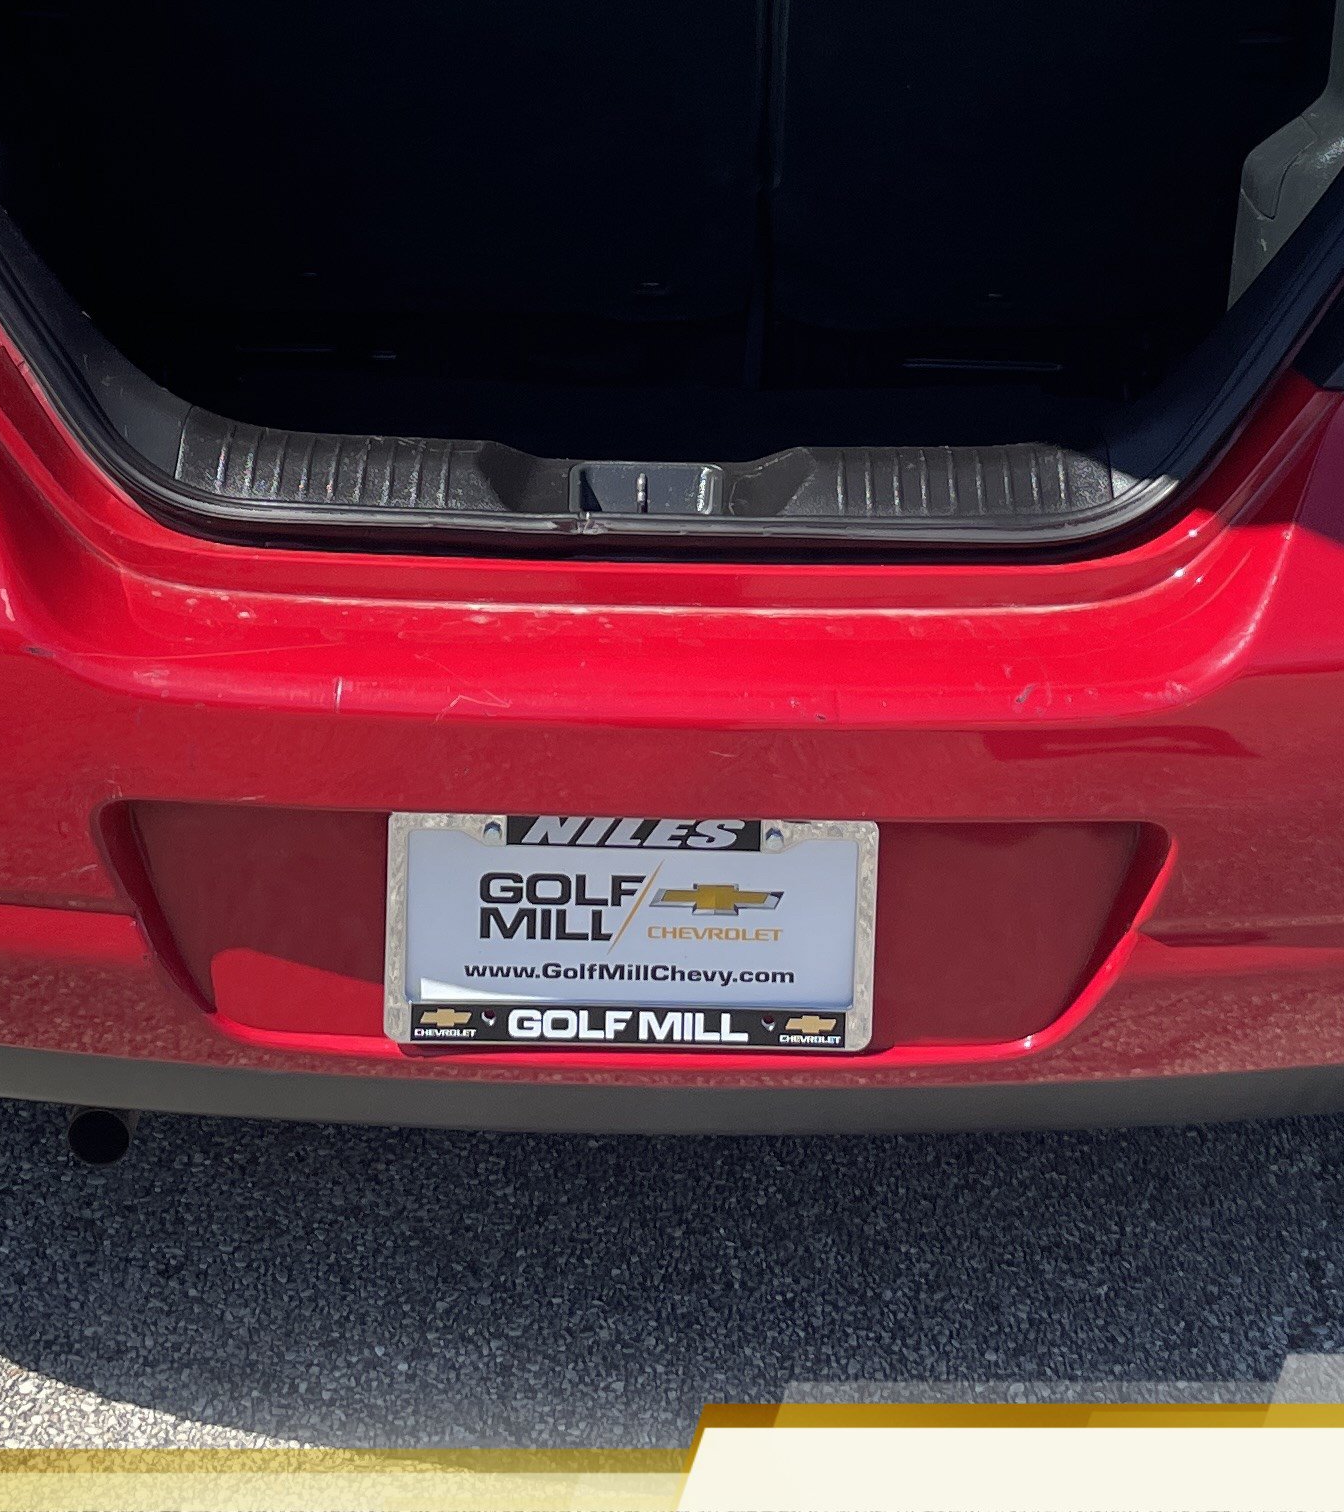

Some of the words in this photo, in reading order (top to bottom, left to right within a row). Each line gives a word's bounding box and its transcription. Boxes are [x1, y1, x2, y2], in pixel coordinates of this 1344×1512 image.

[520, 816, 746, 849] NILES
[479, 872, 646, 907] GOLF
[480, 908, 613, 942] MILL
[647, 926, 784, 942] CHEVROLET
[464, 962, 795, 987] www.GolfMillChevy.com
[508, 1009, 634, 1040] GOLF
[638, 1013, 749, 1043] MILL
